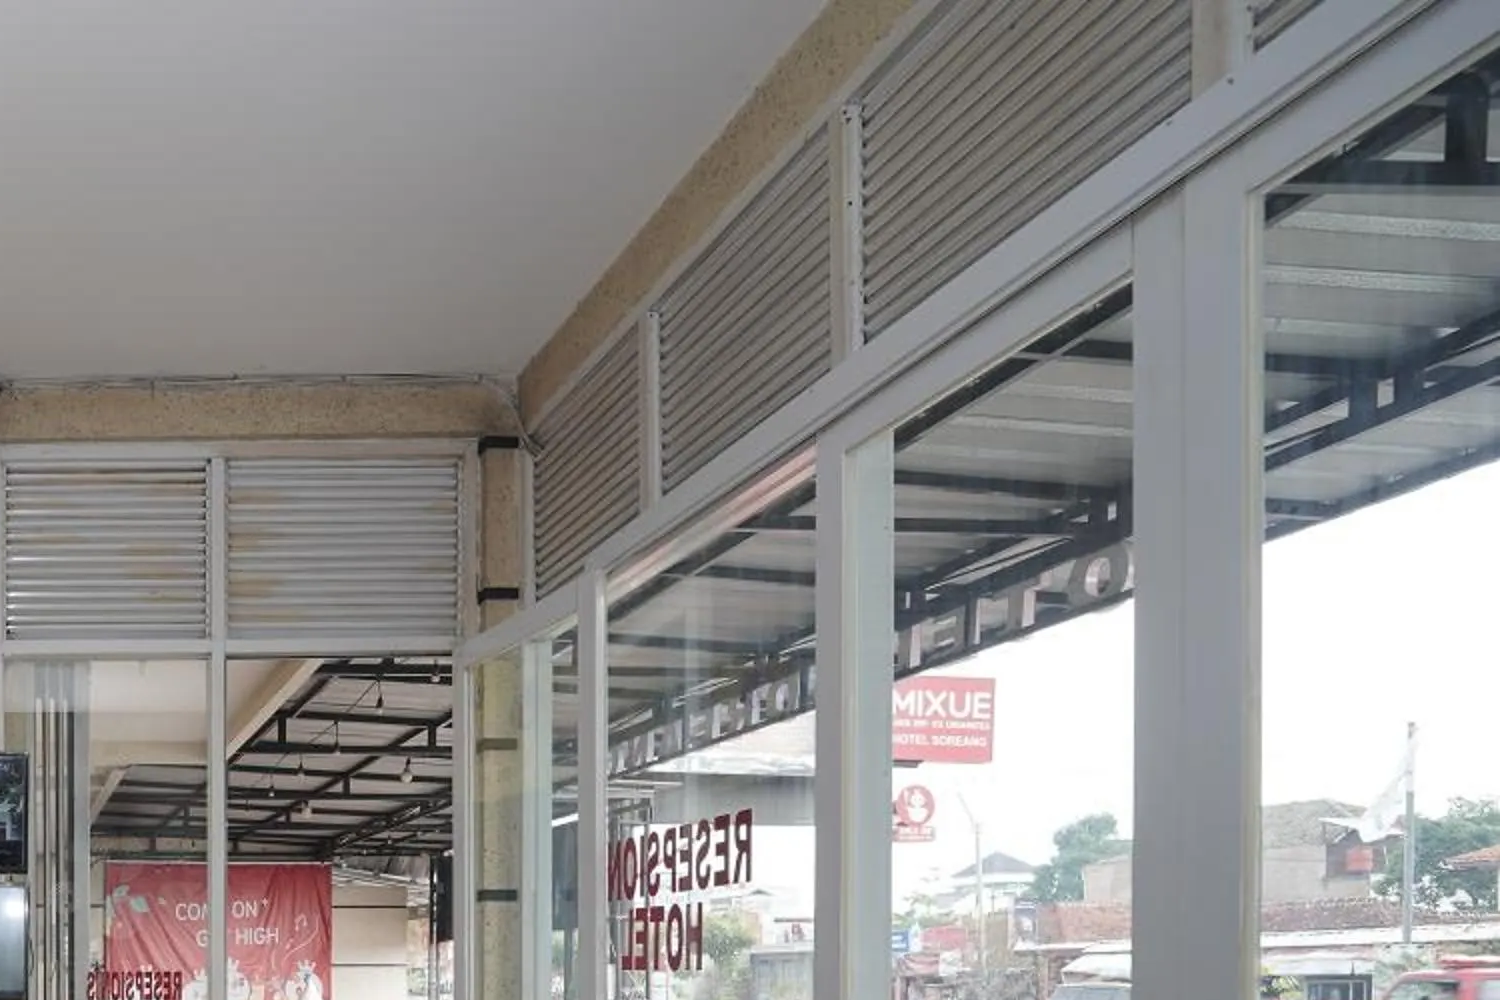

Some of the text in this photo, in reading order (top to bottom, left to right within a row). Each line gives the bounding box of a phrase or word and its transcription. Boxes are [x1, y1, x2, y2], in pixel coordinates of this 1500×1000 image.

[892, 689, 990, 719] MIXUE
[231, 901, 259, 918] ON
[235, 927, 279, 946] HIGH
